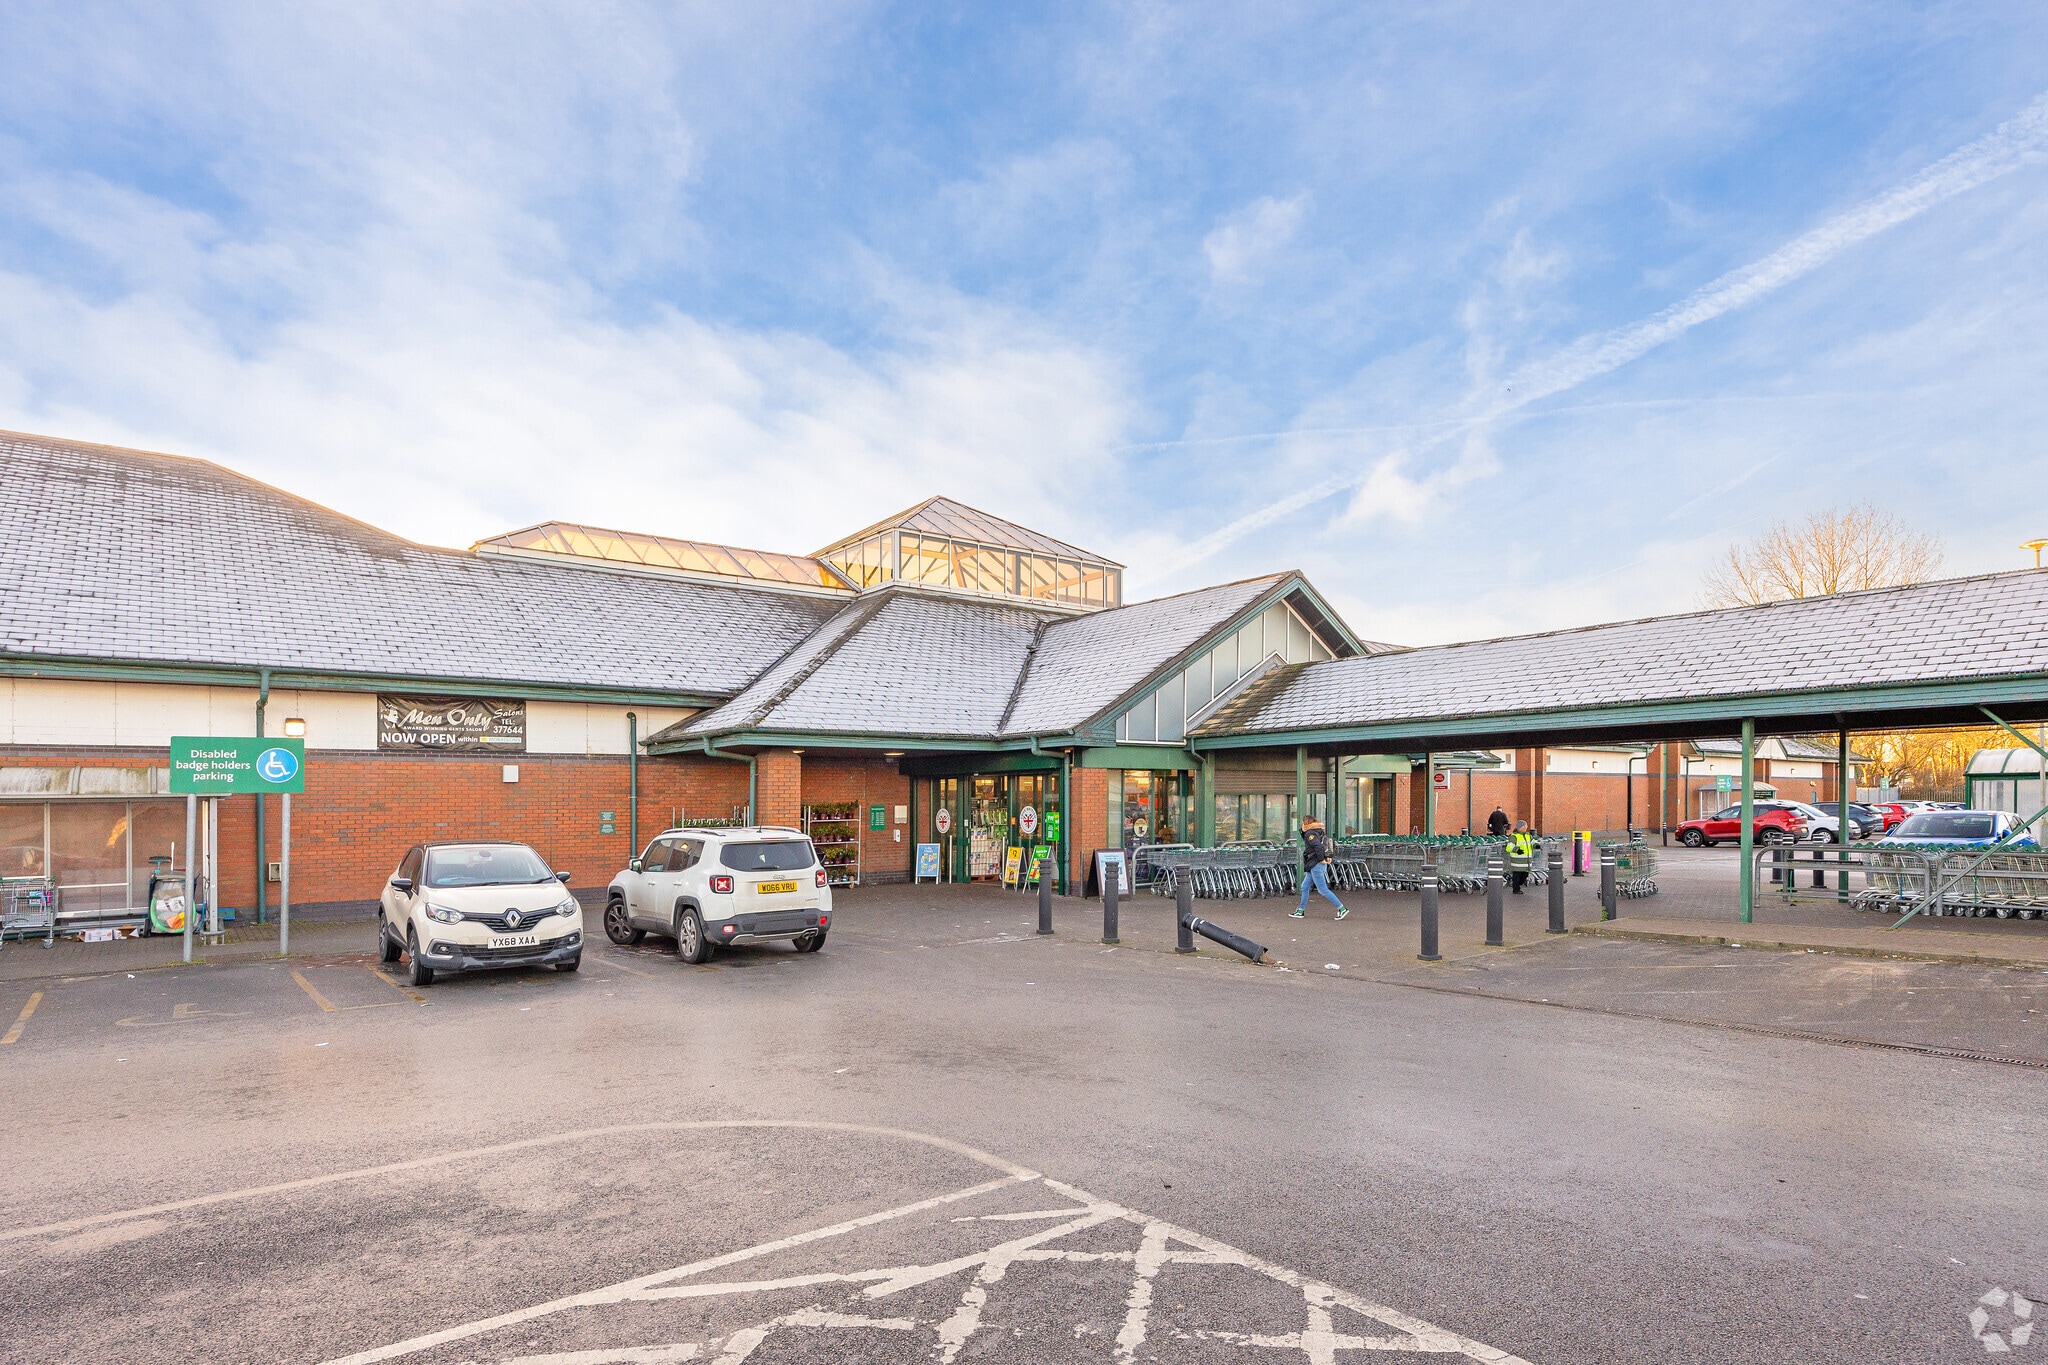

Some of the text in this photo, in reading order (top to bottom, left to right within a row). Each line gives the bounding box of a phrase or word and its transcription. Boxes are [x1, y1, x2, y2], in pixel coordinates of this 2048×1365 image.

[398, 708, 492, 731] Men Only
[492, 708, 524, 720] Salons
[501, 718, 515, 726] TEL:
[493, 725, 523, 734] 377644
[381, 732, 417, 743] NOW
[420, 733, 456, 744] OPEN
[190, 749, 237, 759] Disabled
[175, 760, 251, 771] badge holders
[192, 771, 234, 783] parking
[781, 883, 795, 891] VRU
[492, 936, 536, 947] YX68 XAA
